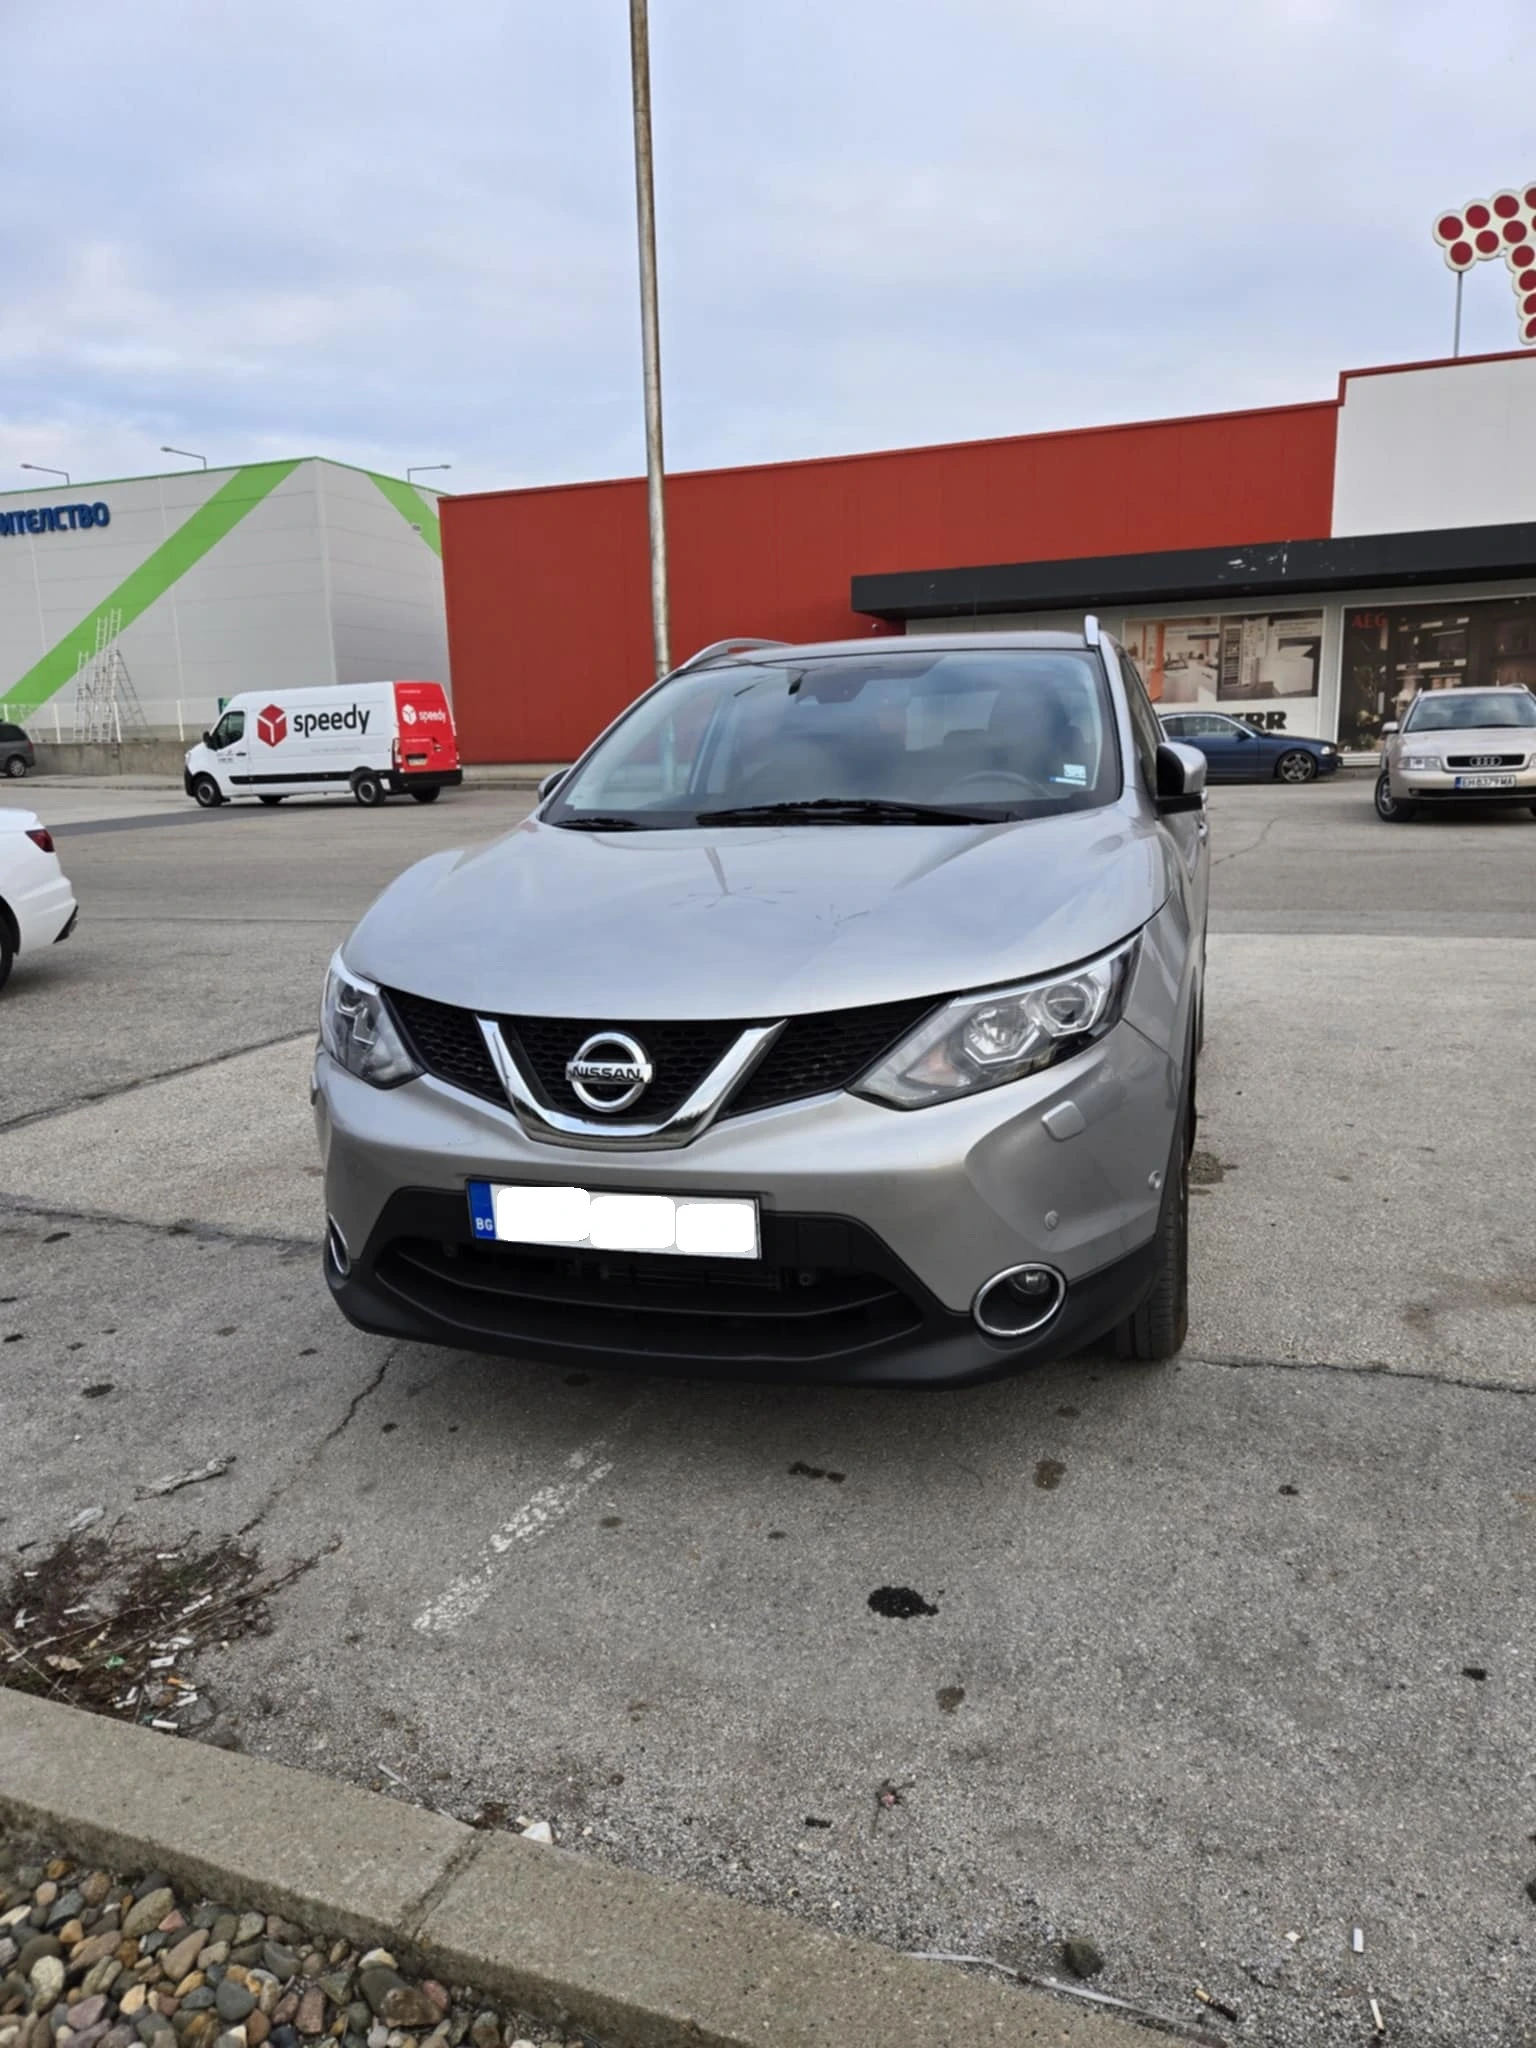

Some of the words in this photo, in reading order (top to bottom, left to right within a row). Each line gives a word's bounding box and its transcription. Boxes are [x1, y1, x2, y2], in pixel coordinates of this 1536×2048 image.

[293, 703, 370, 738] speedy
[418, 708, 446, 724] speedy
[571, 1066, 641, 1081] NISSAN
[475, 1216, 494, 1231] BG
